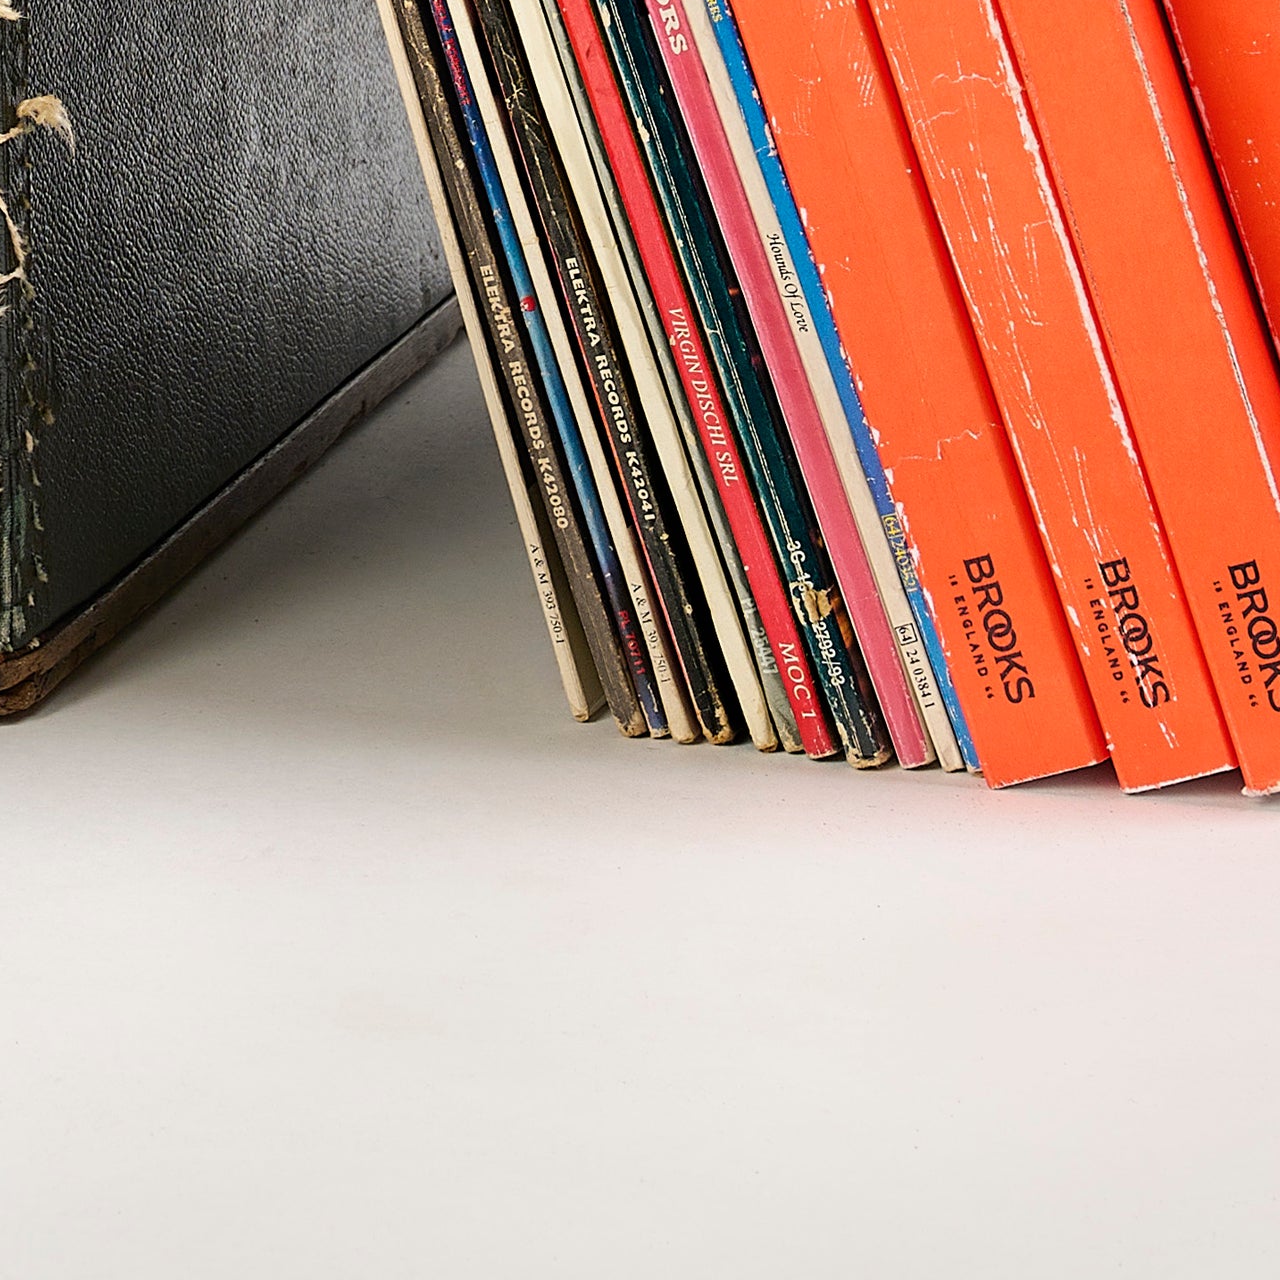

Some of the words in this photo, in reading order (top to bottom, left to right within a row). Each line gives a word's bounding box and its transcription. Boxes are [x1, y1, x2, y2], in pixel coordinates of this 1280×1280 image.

[766, 233, 795, 281] Hounds
[782, 283, 803, 302] Of
[790, 302, 809, 333] Love
[479, 264, 516, 355] ELEKTRA
[508, 360, 545, 450] RECORDS
[537, 457, 569, 529] K42080
[565, 256, 601, 348] ELEKTRA
[595, 354, 632, 445] RECORDS
[625, 450, 657, 522] K42041
[668, 307, 704, 374] VIRGIN
[691, 380, 727, 446] DISCHI
[716, 451, 740, 487] SRL
[884, 517, 901, 538] 64
[529, 543, 540, 554] A
[534, 558, 544, 568] &
[538, 572, 549, 585] M
[631, 582, 642, 593] A
[542, 590, 556, 611] 393
[636, 597, 647, 607] &
[550, 614, 565, 644] 750-1
[640, 610, 652, 625] M
[963, 553, 1036, 704] BROOKS
[898, 626, 914, 643] 64
[954, 595, 988, 677] ENGLAND
[1089, 599, 1124, 681] ENGLAND
[1099, 557, 1170, 709] BROOKS
[1218, 602, 1253, 685] ENGLAND
[778, 641, 812, 701] MOC
[801, 709, 817, 719] 1
